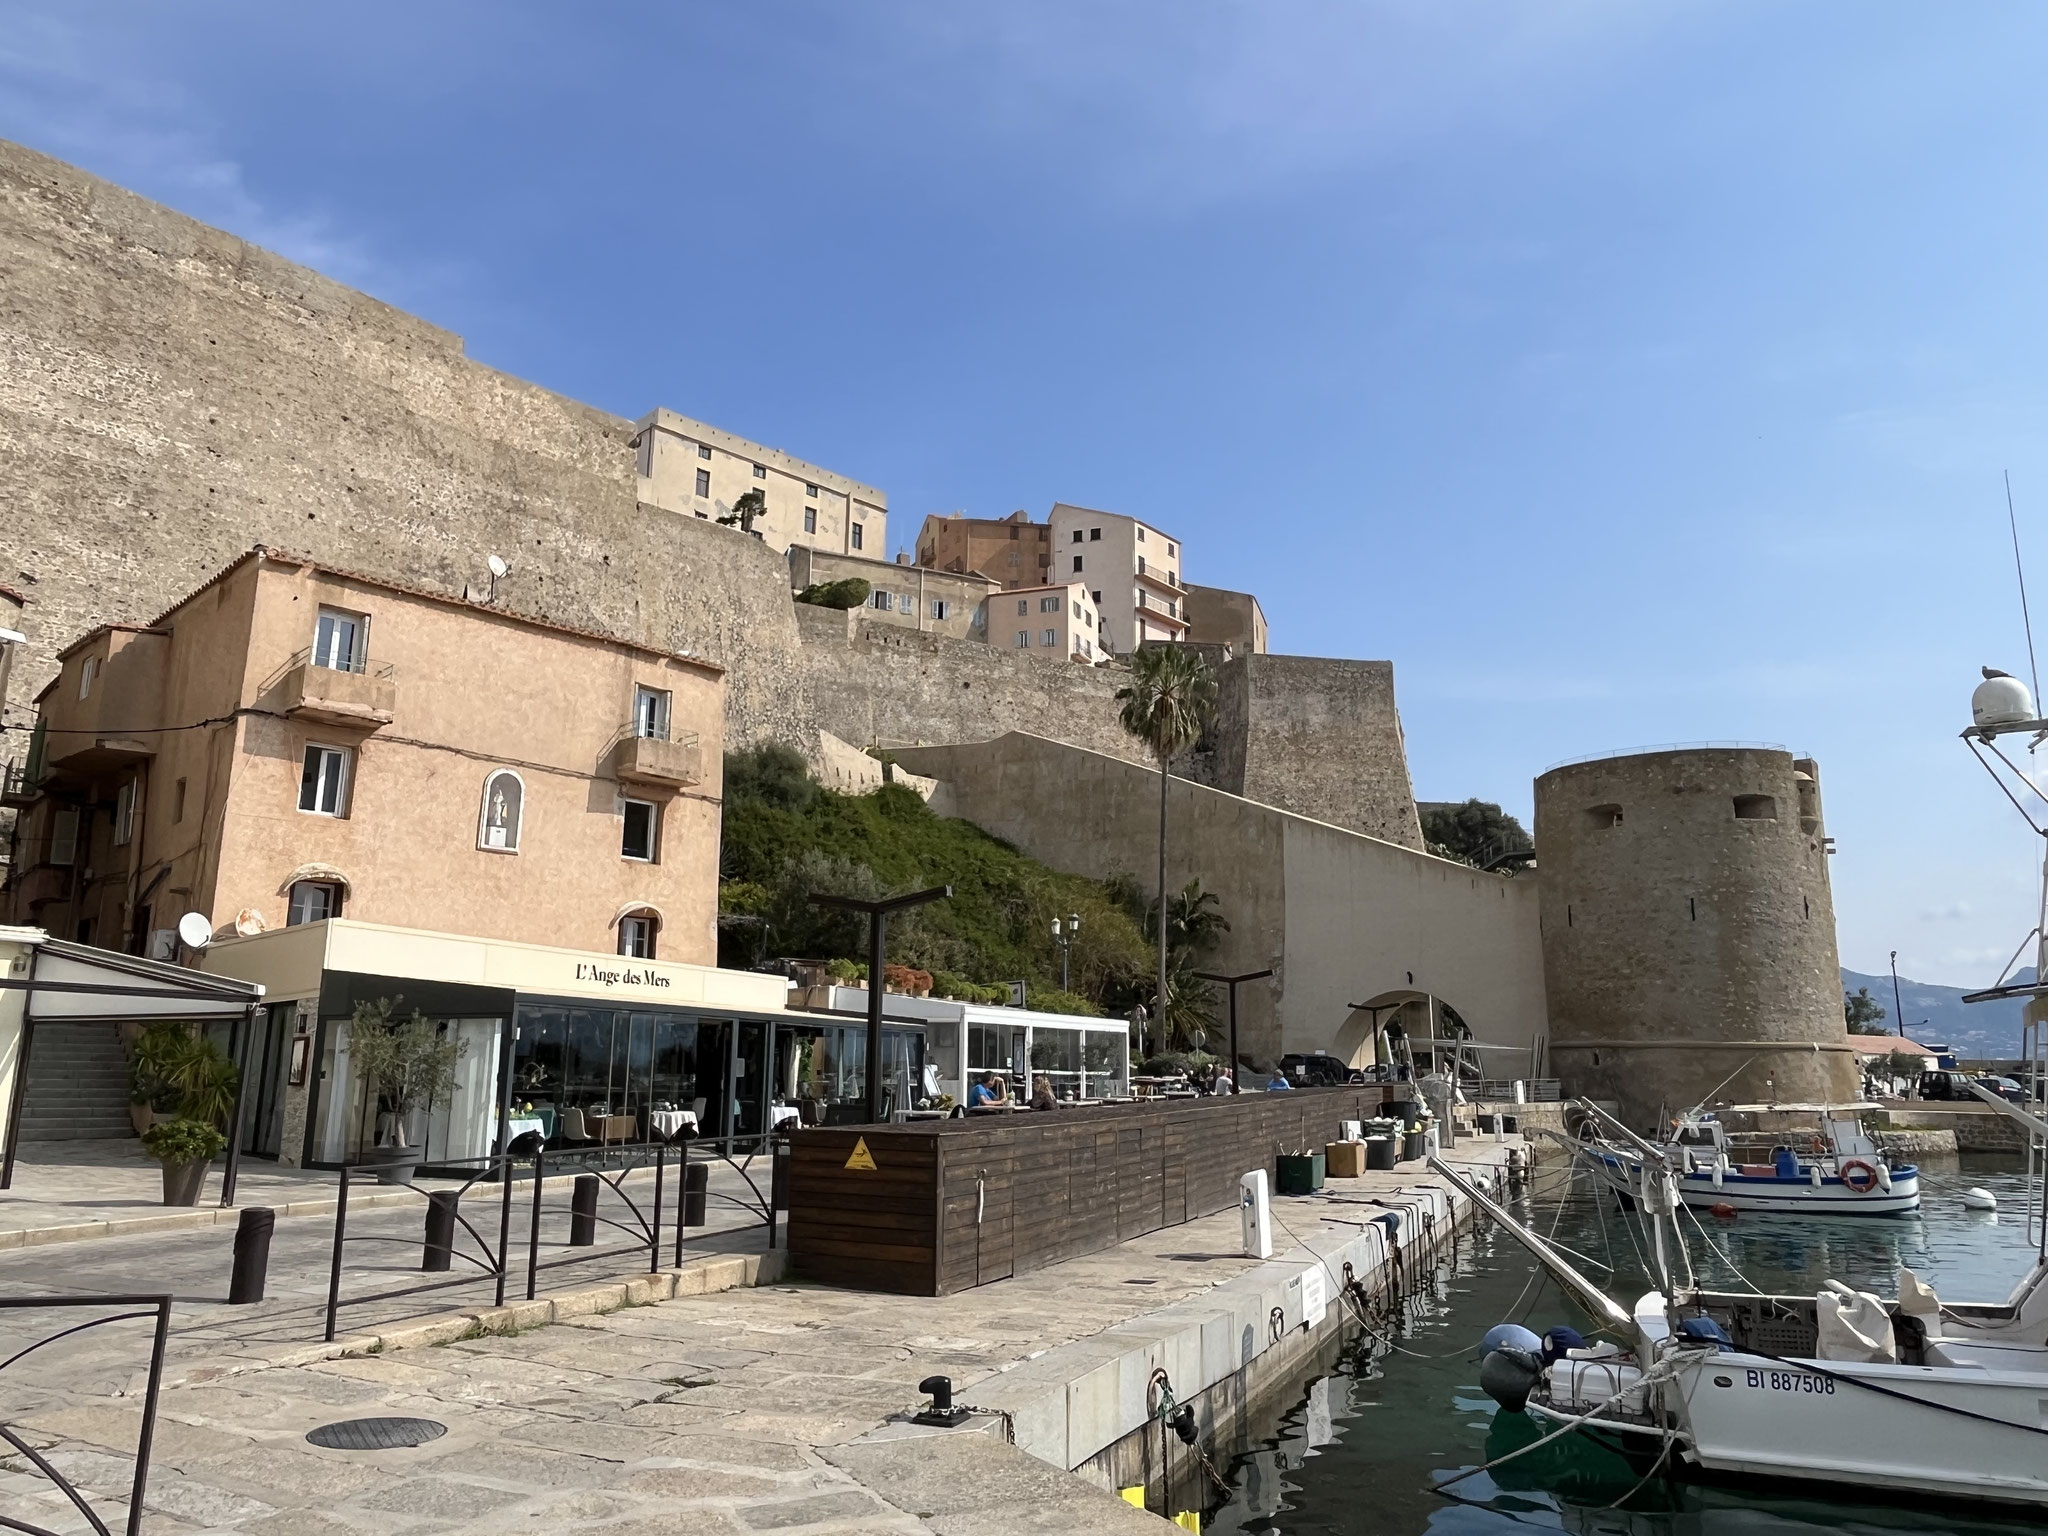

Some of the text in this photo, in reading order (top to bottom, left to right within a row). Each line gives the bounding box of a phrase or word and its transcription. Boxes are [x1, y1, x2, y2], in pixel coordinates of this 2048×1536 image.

[623, 968, 641, 985] des
[644, 969, 670, 988] Mers
[1746, 1369, 1836, 1395] BI 887508
